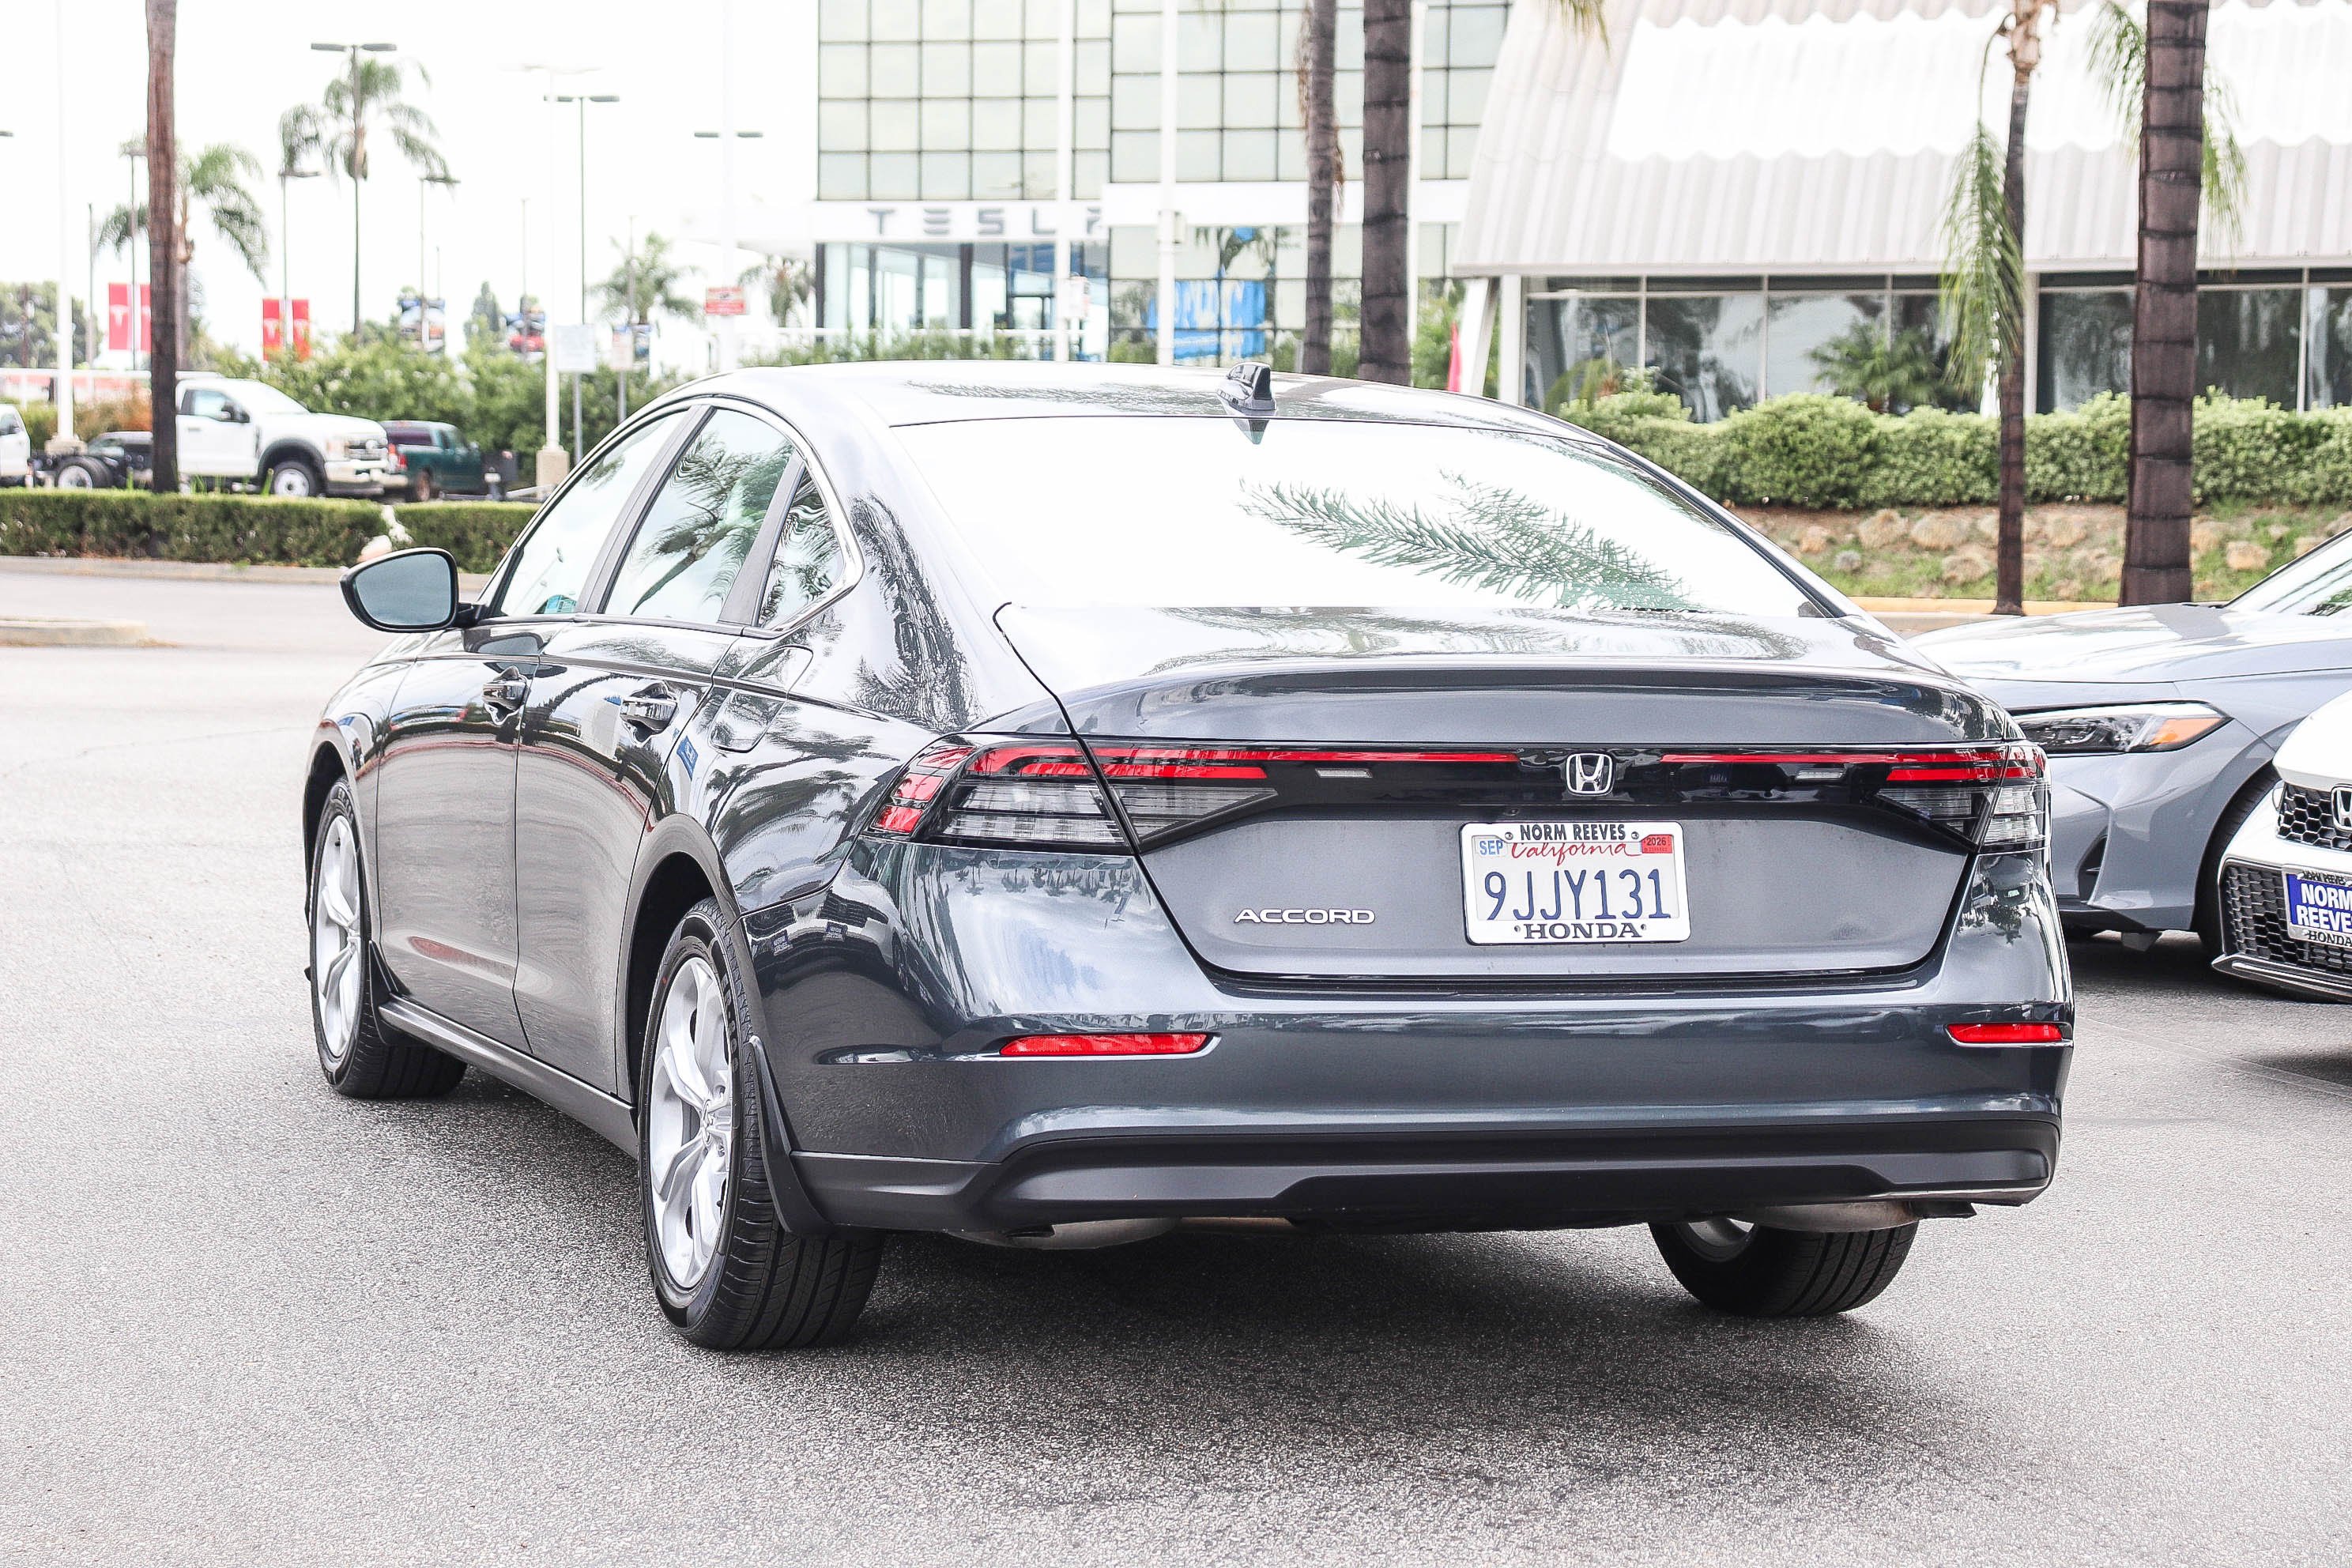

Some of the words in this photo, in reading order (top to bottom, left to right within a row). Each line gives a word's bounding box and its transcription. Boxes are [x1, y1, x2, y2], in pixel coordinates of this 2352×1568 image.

[1520, 824, 1567, 841] NORM
[1573, 824, 1626, 841] REEVES
[1646, 836, 1667, 846] 2026
[1479, 839, 1504, 856] SEP
[1511, 842, 1642, 866] California
[1484, 868, 1672, 921] 9JJY131
[2301, 883, 2352, 911] NORM
[1234, 908, 1376, 925] ACCORD
[2296, 904, 2352, 933] REEVE
[1523, 922, 1642, 940] HONDA
[2308, 929, 2352, 947] HONDA
